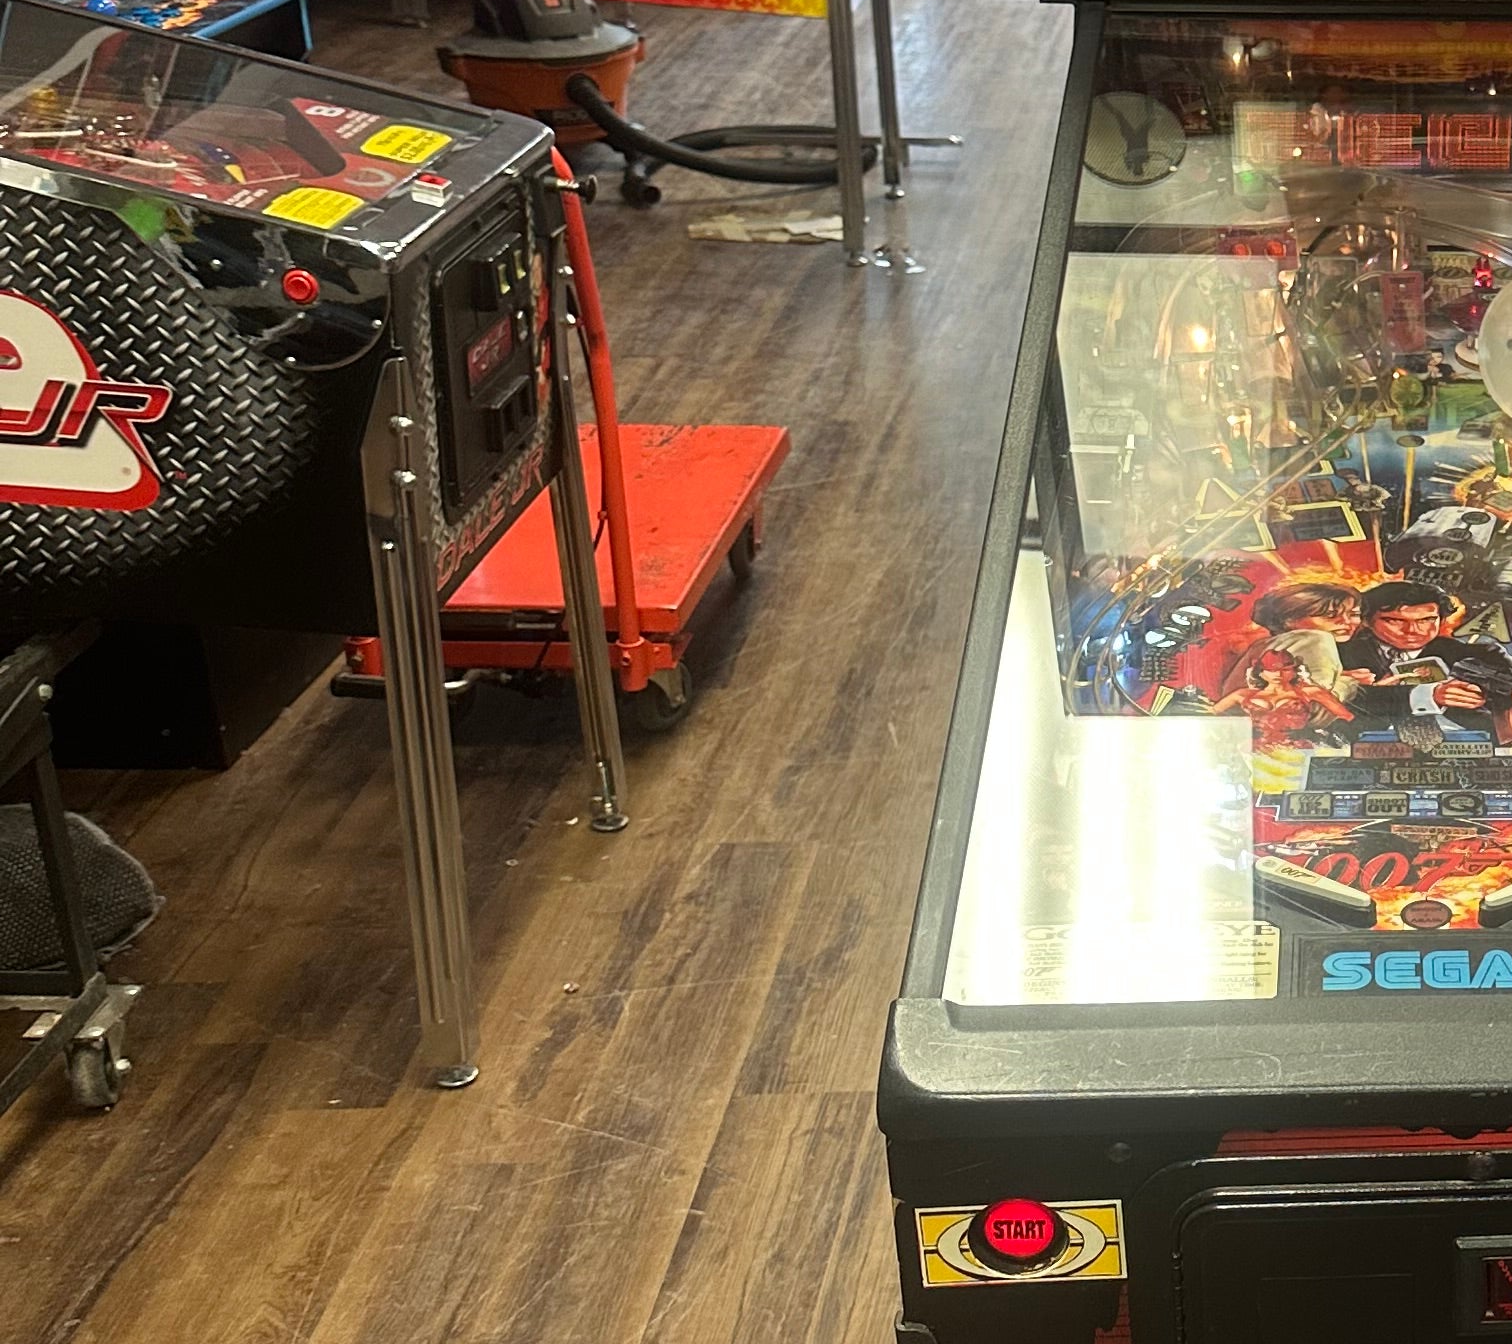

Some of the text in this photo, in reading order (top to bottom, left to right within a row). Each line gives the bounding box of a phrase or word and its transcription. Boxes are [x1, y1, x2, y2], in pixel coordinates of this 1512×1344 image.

[1395, 768, 1451, 784] CRASH
[1367, 804, 1404, 813] OUT
[1282, 866, 1309, 878] 007
[992, 1219, 1046, 1241] START
